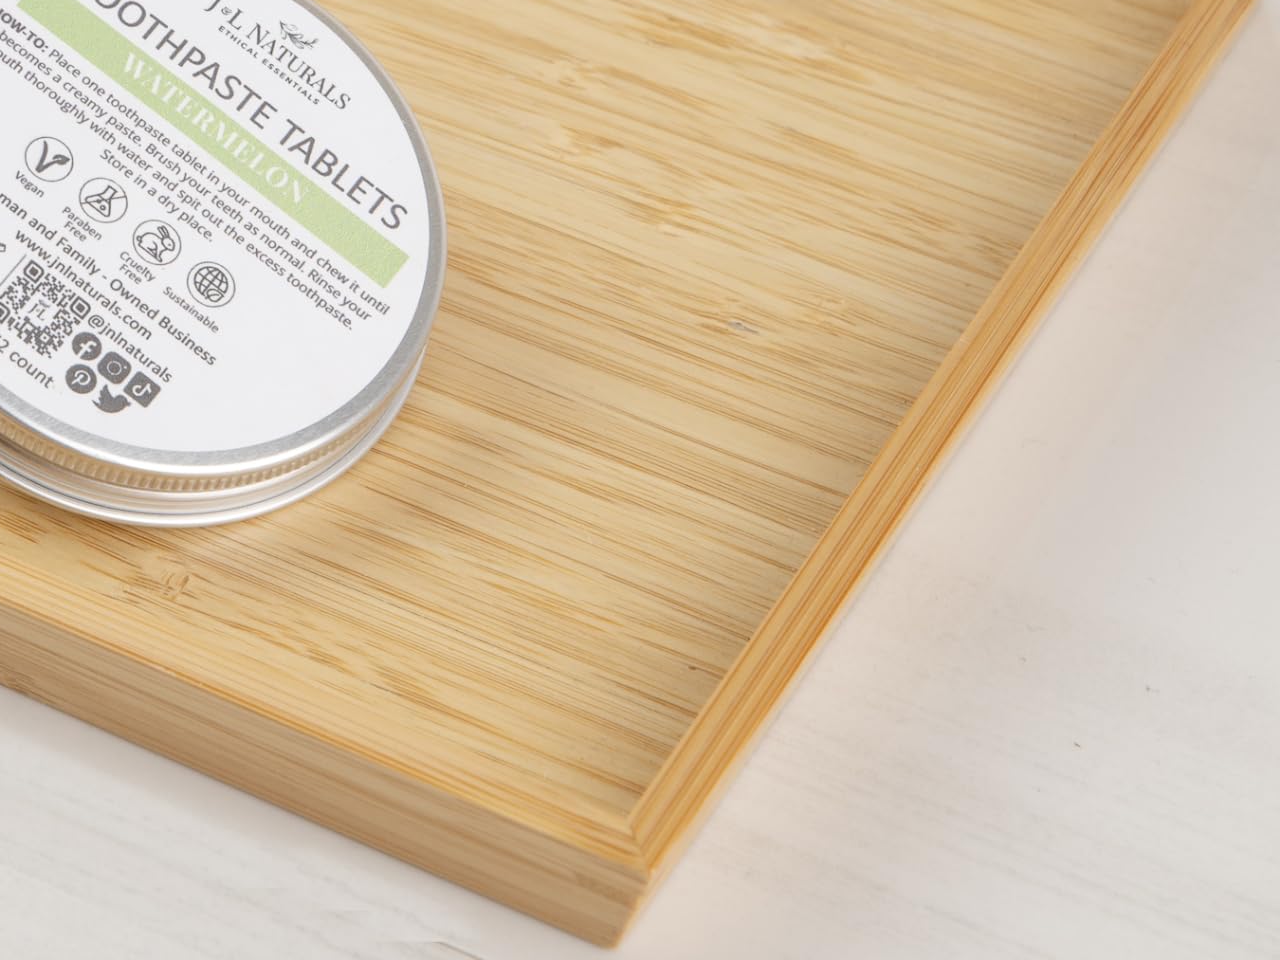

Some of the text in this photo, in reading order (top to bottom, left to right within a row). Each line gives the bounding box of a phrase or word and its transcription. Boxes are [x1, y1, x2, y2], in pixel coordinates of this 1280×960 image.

[217, 24, 320, 105] ETHICAL ESSENTIALS
[245, 22, 351, 110] NATURALS
[123, 51, 310, 205] WATERMELON
[14, 169, 44, 198] Vegan
[23, 70, 90, 124] thoroughly
[89, 120, 116, 145] with
[116, 142, 153, 171] water
[151, 170, 179, 192] and
[176, 189, 201, 210] spit
[200, 208, 223, 228] out
[223, 224, 245, 245] the
[245, 242, 286, 276] excess
[286, 272, 352, 330] toothpaste.
[47, 48, 81, 78] Place
[81, 75, 106, 97] one
[105, 93, 171, 146] toothpaste
[170, 143, 207, 175] tablet
[206, 172, 220, 185] in
[217, 182, 250, 206] your
[249, 205, 290, 240] mouth
[290, 238, 318, 259] and
[316, 257, 350, 284] chew
[348, 282, 360, 293] it
[359, 290, 390, 315] until
[51, 73, 62, 83] a
[62, 81, 108, 118] creamy
[104, 115, 141, 147] paste.
[144, 142, 181, 175] Brush
[178, 171, 212, 196] your
[210, 194, 244, 224] teeth
[243, 221, 260, 236] as
[259, 233, 306, 273] normal.
[307, 268, 341, 299] Rinse
[338, 295, 371, 320] your
[99, 148, 212, 242] Store in a dry place.
[279, 118, 408, 229] TABLETS
[61, 205, 102, 241] Paraben
[63, 220, 87, 242] Free
[14, 229, 152, 340] www.jnlnaturals.com
[27, 217, 58, 241] and
[55, 236, 101, 276] Family
[109, 278, 160, 320] Owned
[157, 315, 216, 366] Business
[118, 263, 142, 284] Free
[119, 250, 155, 282] Cruelty
[86, 313, 172, 383] @jnlnaturals
[162, 286, 219, 332] Sustainable
[8, 350, 54, 389] count
